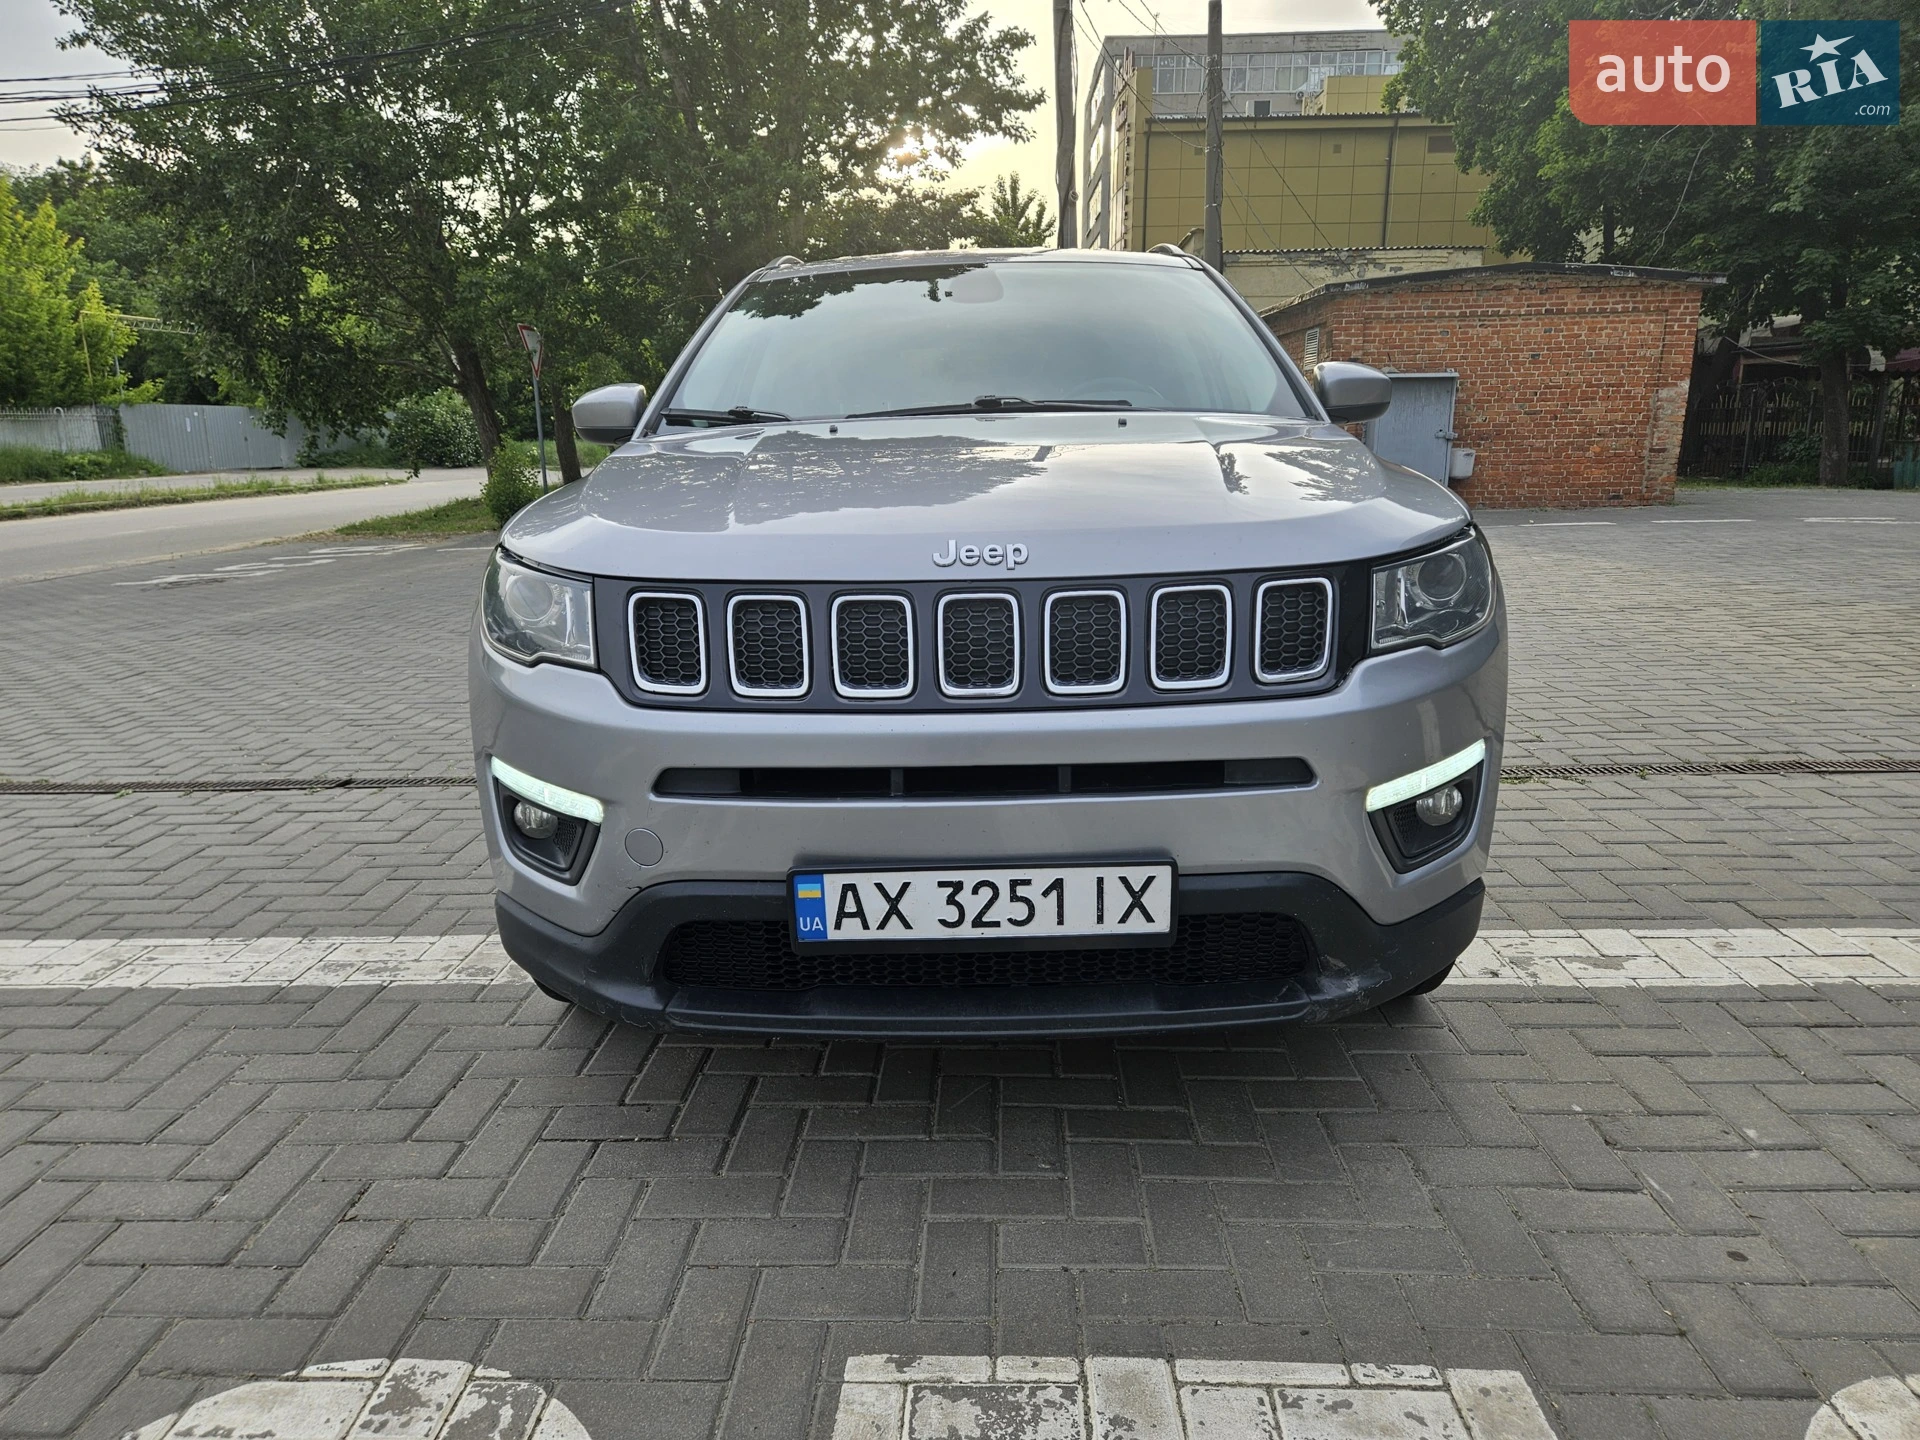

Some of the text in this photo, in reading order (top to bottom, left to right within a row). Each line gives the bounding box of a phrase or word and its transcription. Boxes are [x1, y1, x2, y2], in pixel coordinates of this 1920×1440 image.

[932, 539, 1028, 570] Jeep
[834, 875, 1156, 930] AX 3251 IX
[800, 917, 824, 931] UA
